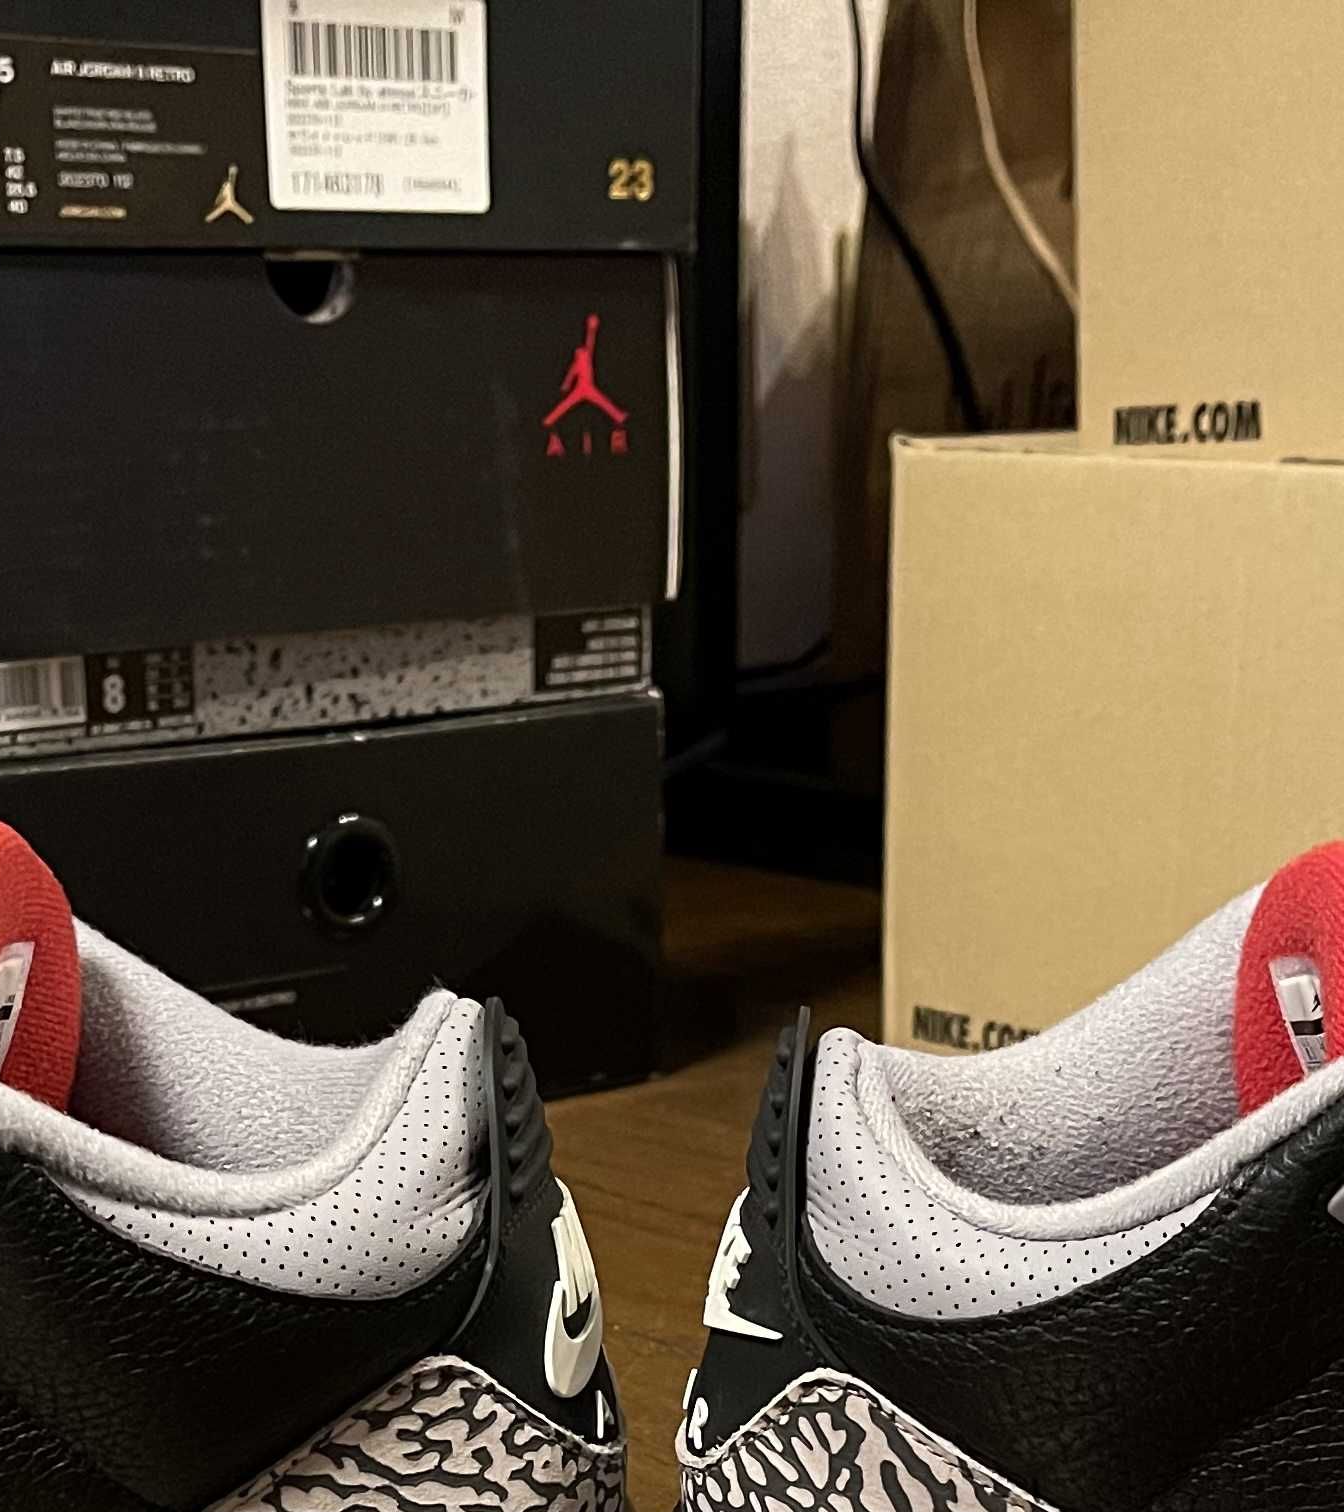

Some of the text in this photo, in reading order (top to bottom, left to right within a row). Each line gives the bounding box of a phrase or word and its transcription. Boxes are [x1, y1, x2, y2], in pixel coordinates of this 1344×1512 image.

[608, 158, 655, 201] 23
[1114, 399, 1261, 445] NIKE.COM
[546, 431, 628, 456] AIR
[102, 673, 126, 714] 8
